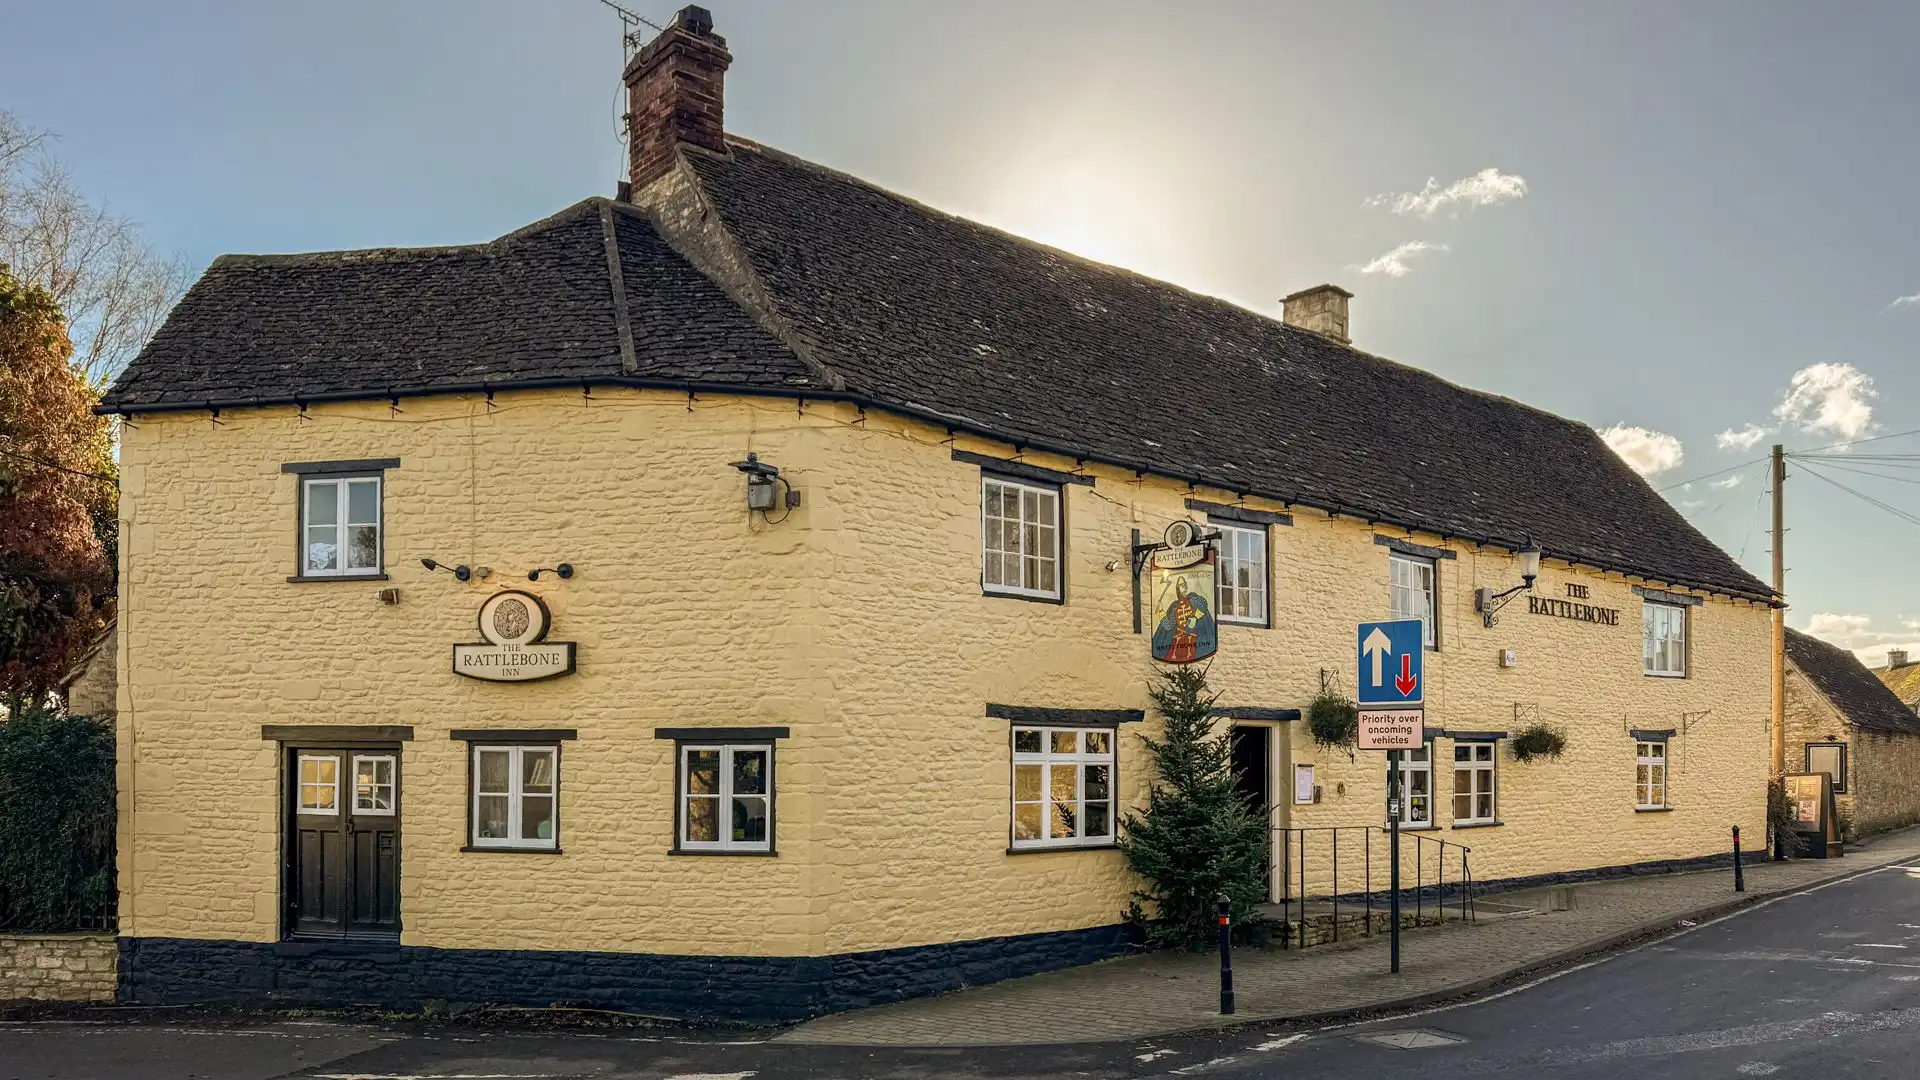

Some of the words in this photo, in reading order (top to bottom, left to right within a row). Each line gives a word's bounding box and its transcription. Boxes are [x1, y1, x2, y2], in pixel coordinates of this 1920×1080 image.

[1157, 549, 1202, 563] RATTLEBONE
[1565, 583, 1589, 599] THE
[1527, 595, 1621, 625] RATTLEBONE
[502, 643, 521, 652] THE
[463, 653, 560, 667] RATTLEBONE
[502, 668, 520, 677] INN
[1362, 715, 1395, 724] Priority
[1398, 715, 1419, 723] over
[1368, 725, 1412, 734] oncoming
[1371, 736, 1409, 744] vehicles
